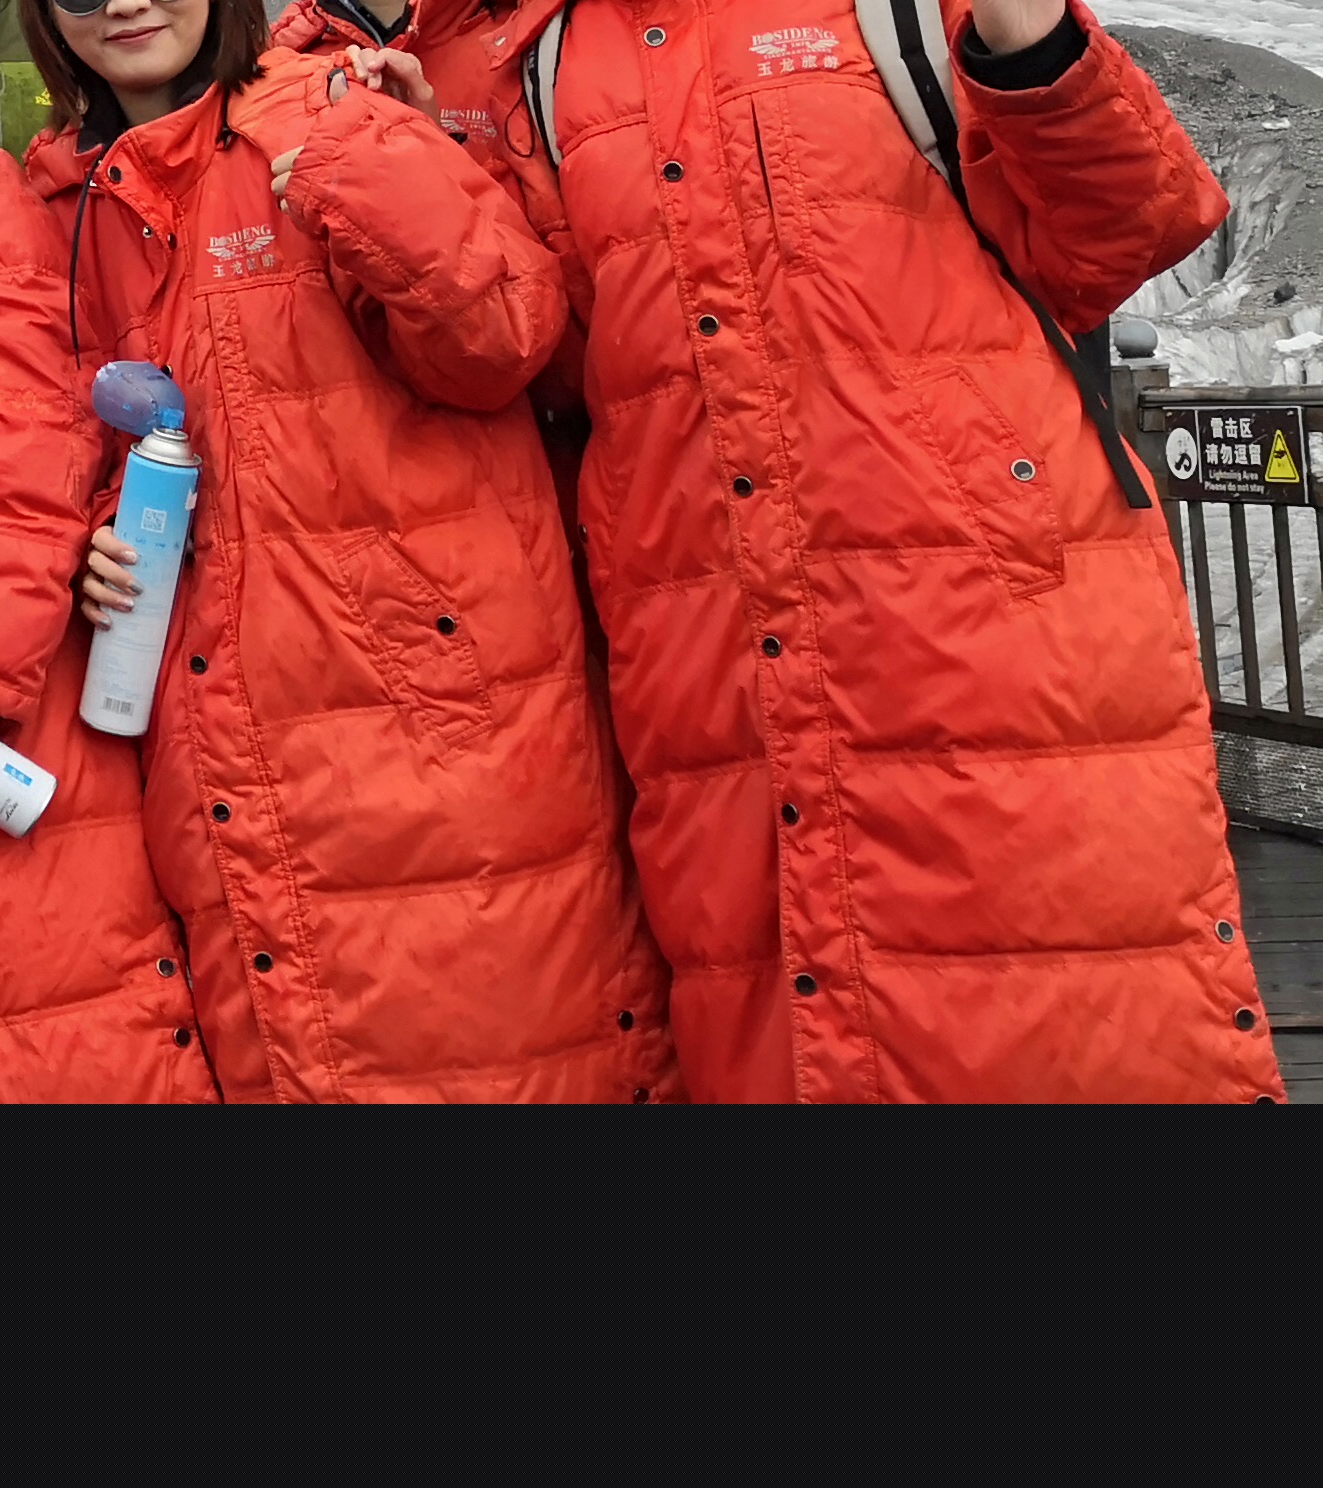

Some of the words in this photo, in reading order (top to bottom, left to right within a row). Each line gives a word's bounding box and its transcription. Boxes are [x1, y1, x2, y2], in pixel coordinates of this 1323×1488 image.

[1210, 417, 1253, 439] 雷击区
[1205, 443, 1262, 466] 请勿逗留
